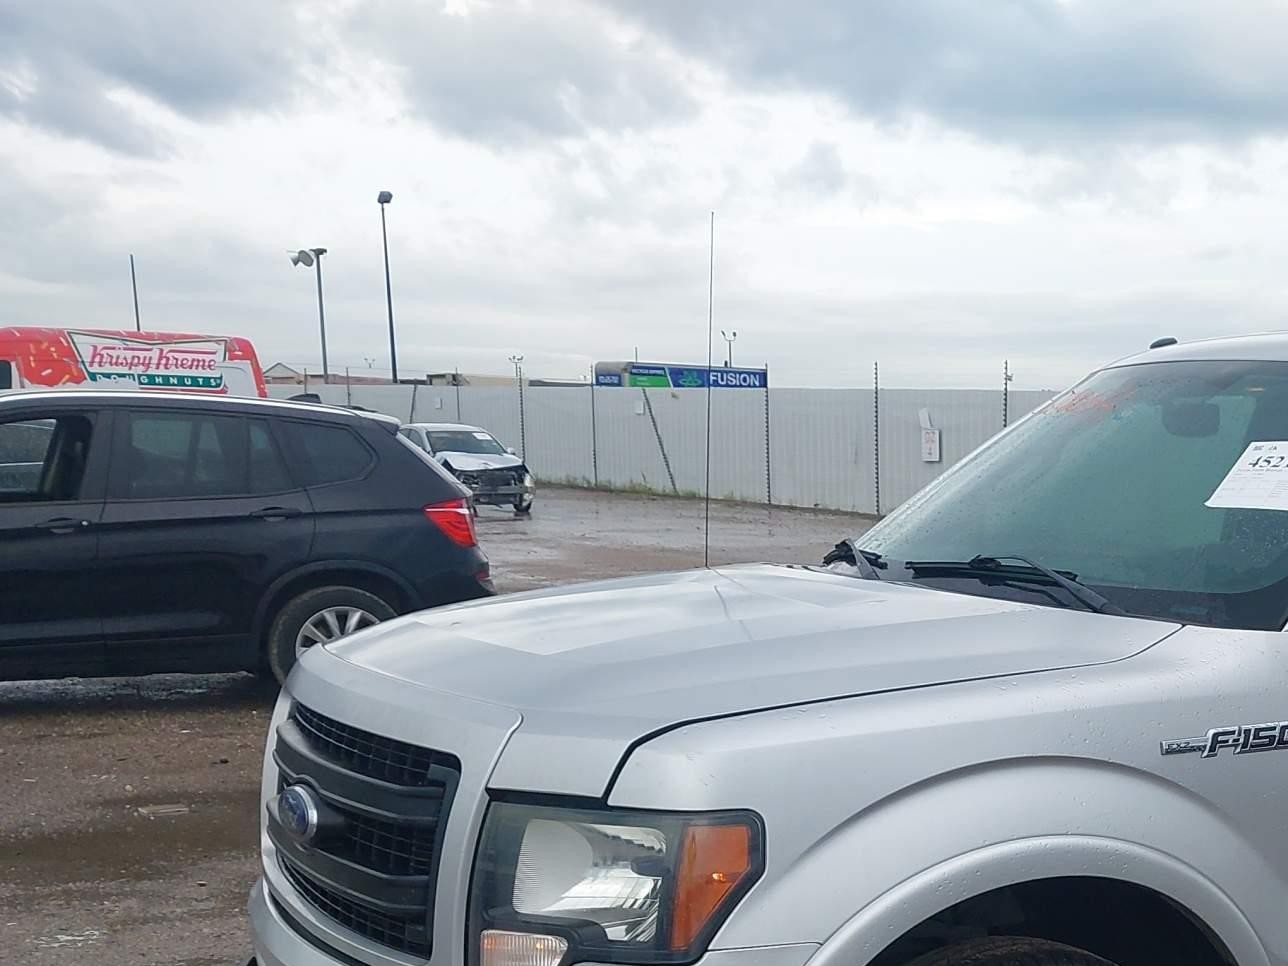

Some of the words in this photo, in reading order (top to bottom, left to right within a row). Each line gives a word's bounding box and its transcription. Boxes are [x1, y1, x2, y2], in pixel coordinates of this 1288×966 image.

[89, 345, 153, 373] Krispy
[155, 348, 217, 371] Kreme
[709, 372, 760, 387] FUSION
